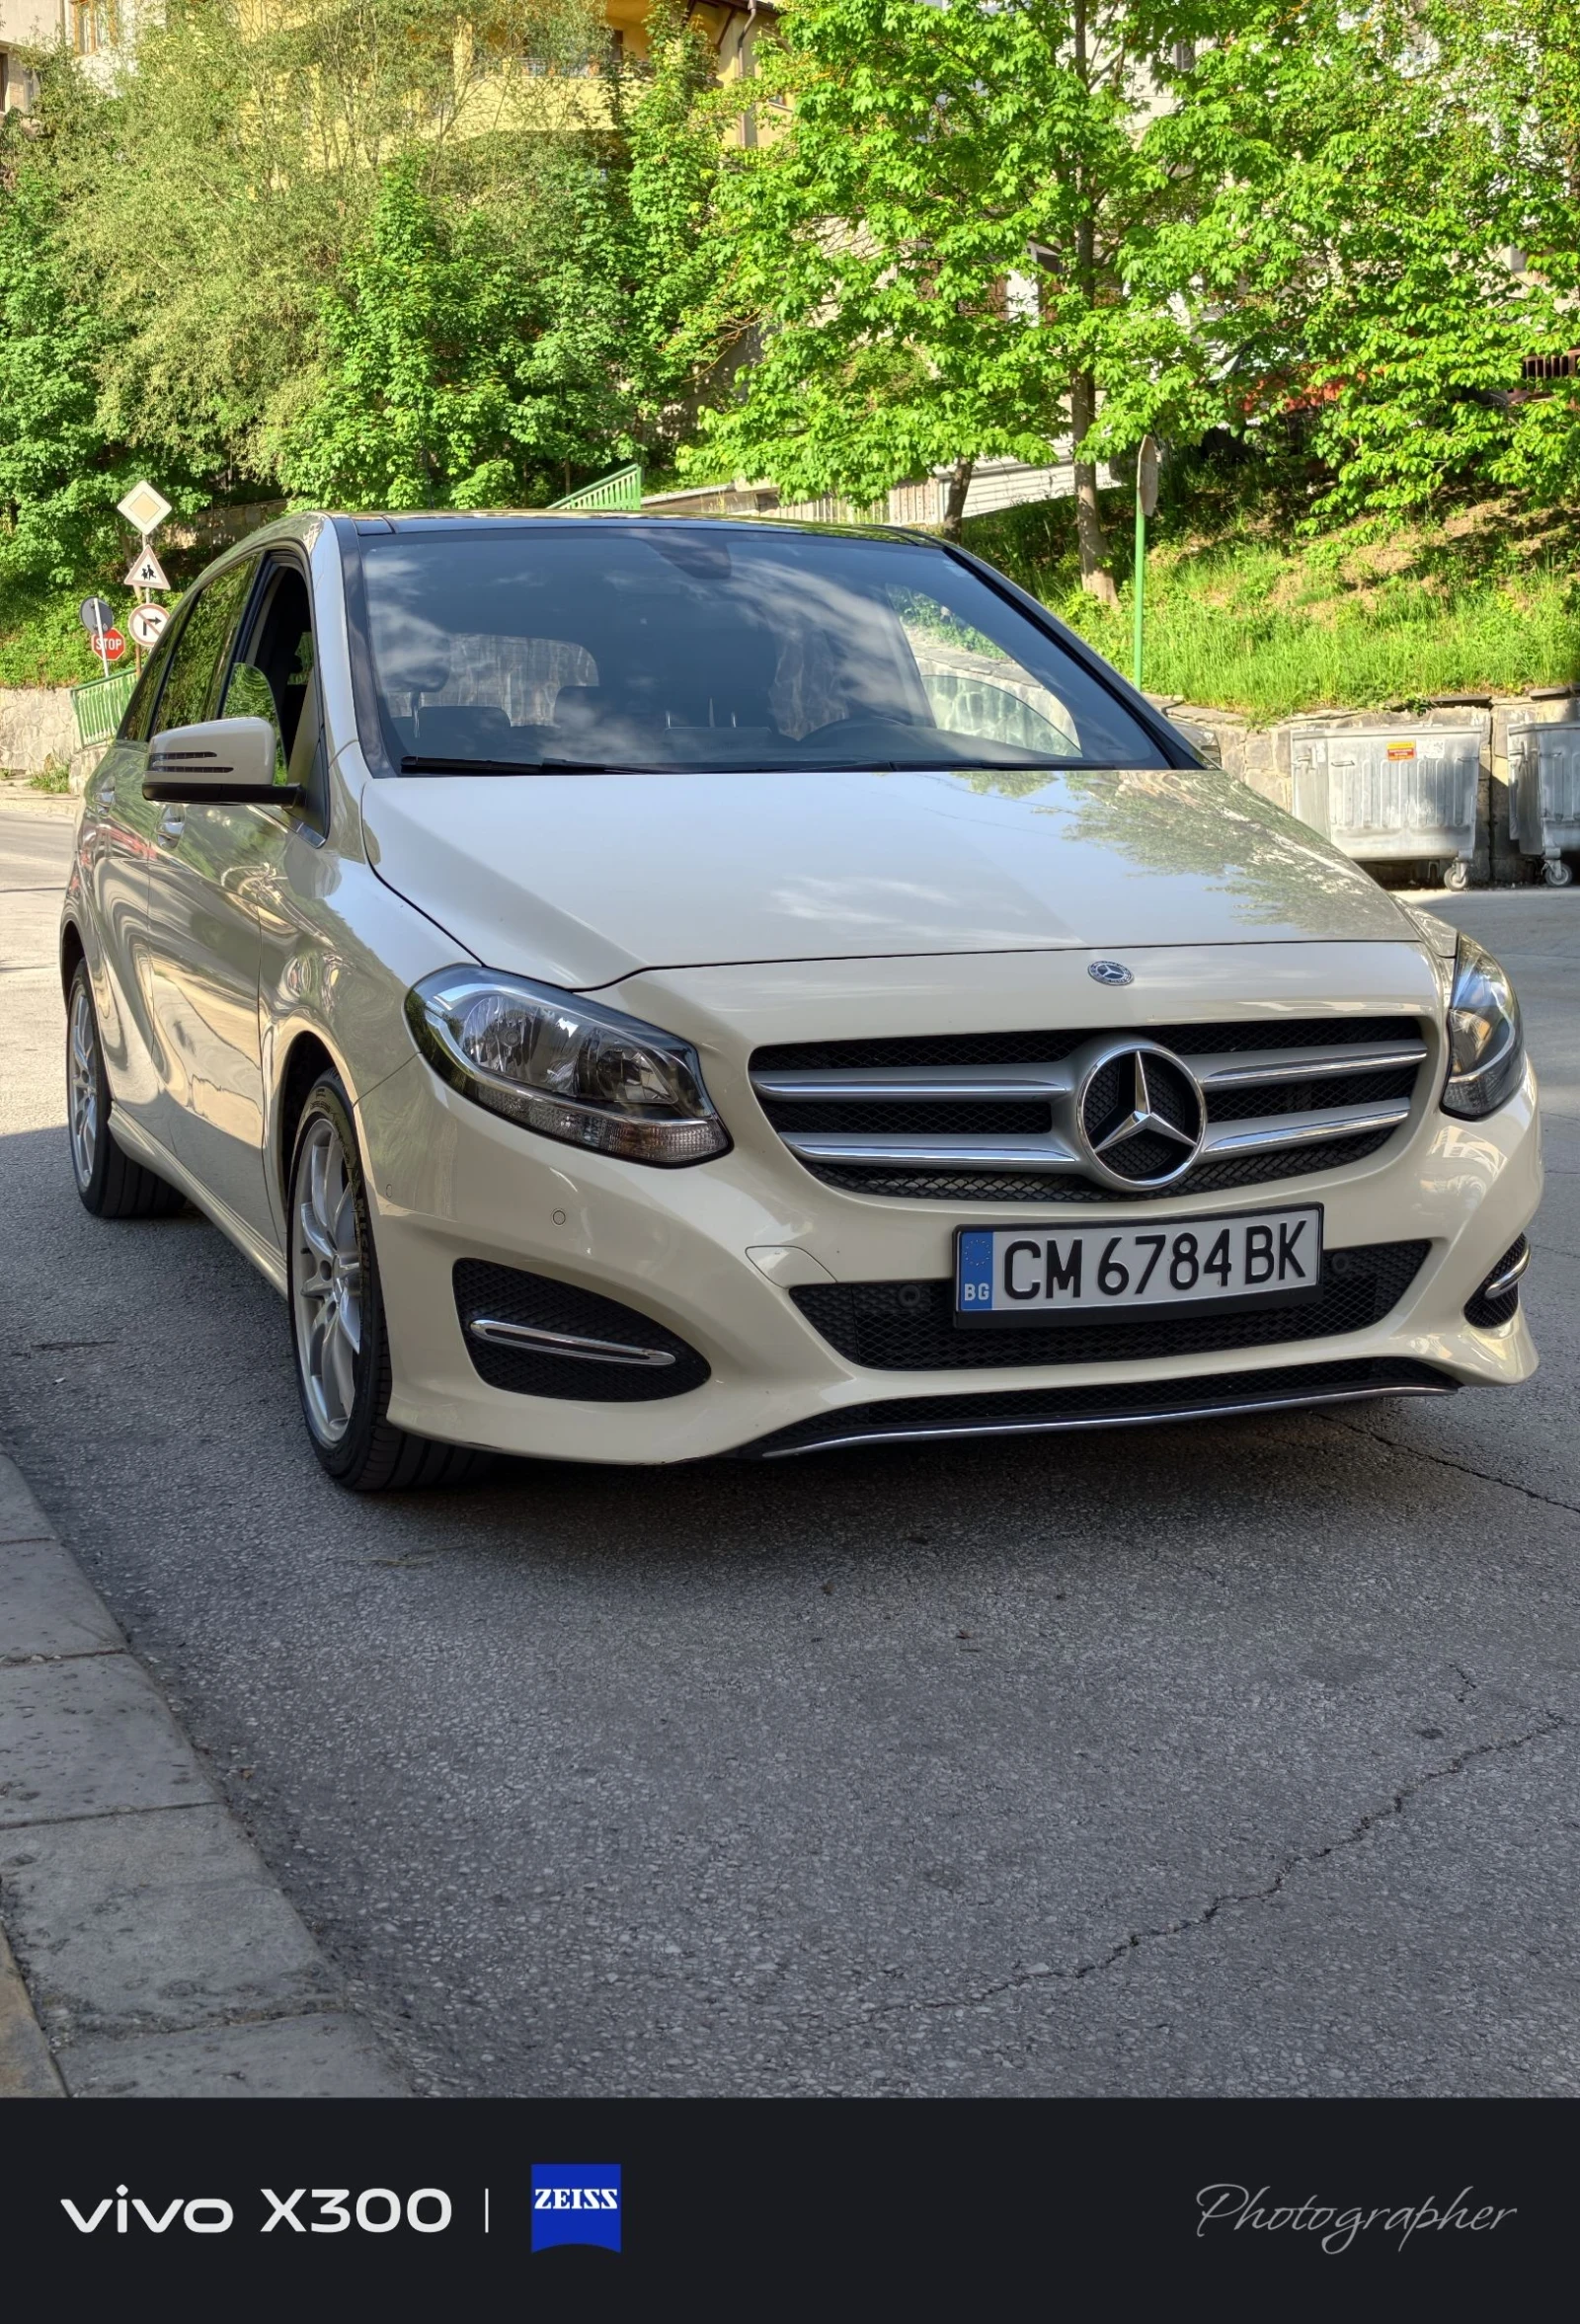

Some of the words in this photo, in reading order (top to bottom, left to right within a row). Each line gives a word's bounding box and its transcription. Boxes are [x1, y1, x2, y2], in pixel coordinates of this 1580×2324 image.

[96, 638, 122, 651] STOP
[1003, 1238, 1083, 1300] CM
[1097, 1228, 1232, 1296] 6784
[1244, 1219, 1307, 1285] BK
[964, 1283, 990, 1301] BG
